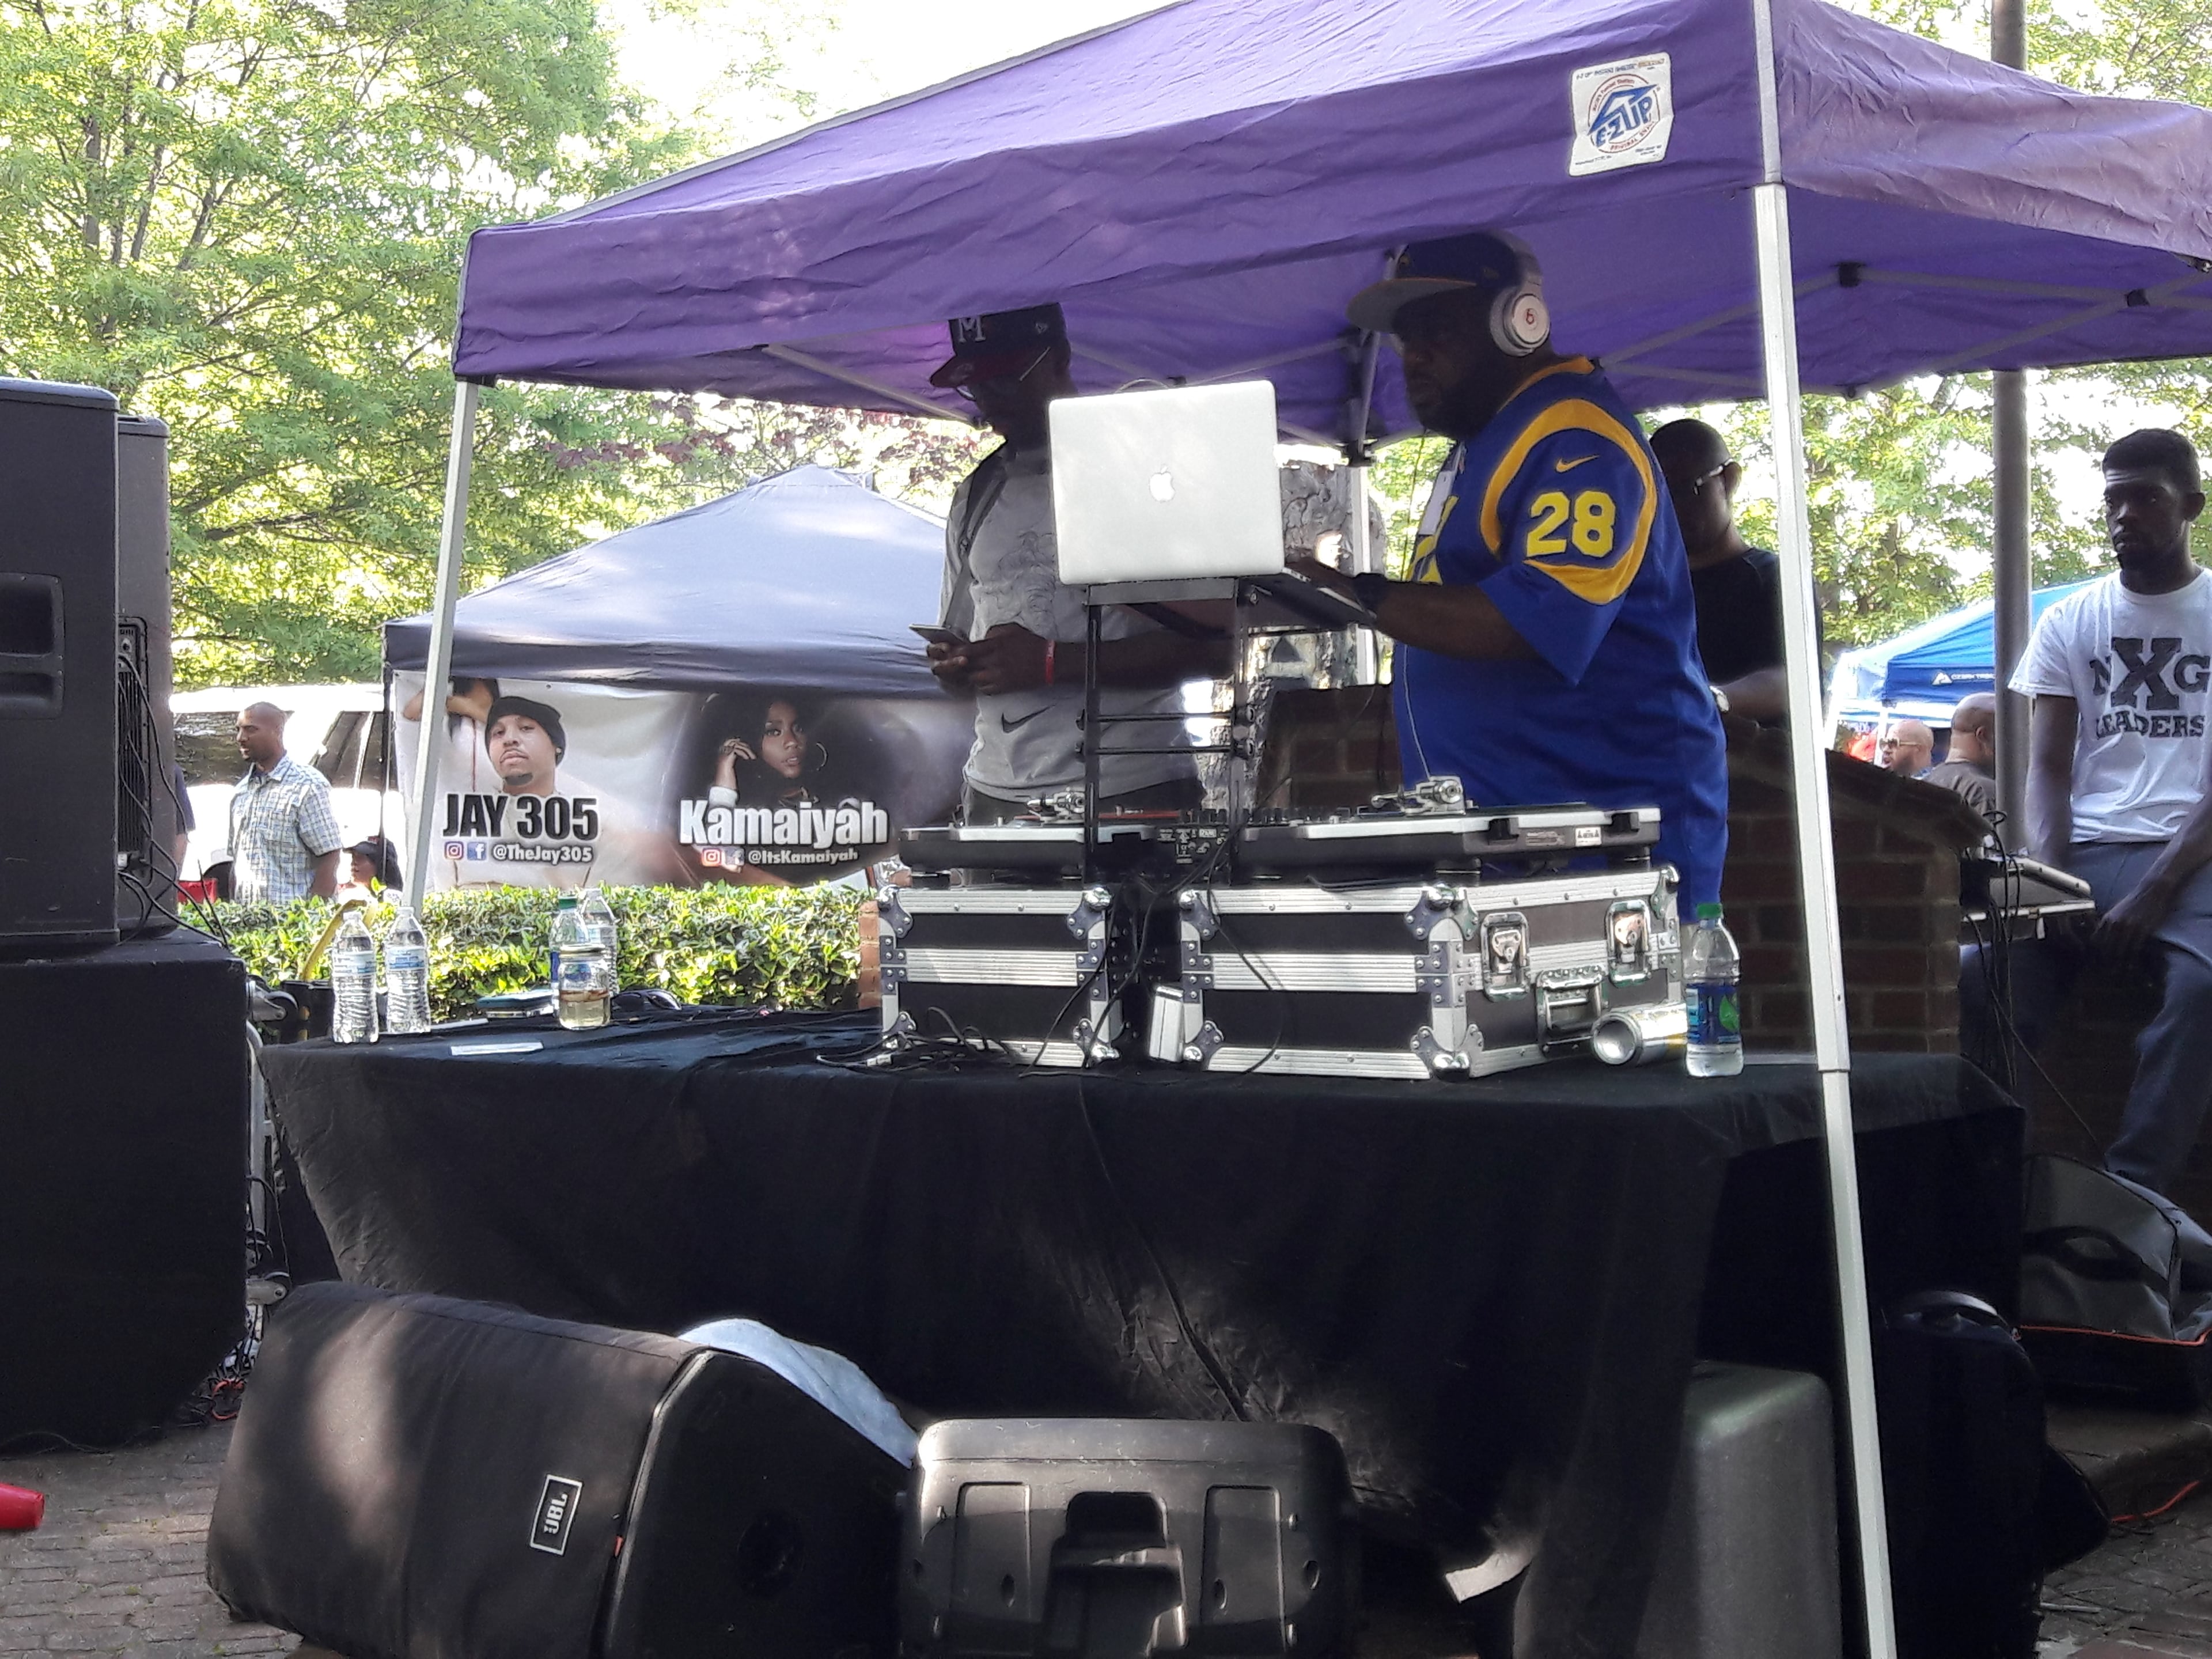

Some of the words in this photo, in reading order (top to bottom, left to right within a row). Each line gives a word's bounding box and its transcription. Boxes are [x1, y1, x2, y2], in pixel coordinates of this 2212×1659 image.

[959, 317, 986, 343] M
[1526, 490, 1616, 558] 28
[2097, 710, 2206, 740] LEADERS
[442, 793, 508, 838] JAY
[516, 796, 599, 841] 305
[680, 799, 888, 849] Kamaiyah
[493, 843, 594, 865] @TheJay305
[748, 848, 858, 865] @ItsKamaiyah
[543, 1494, 568, 1534] JBL
